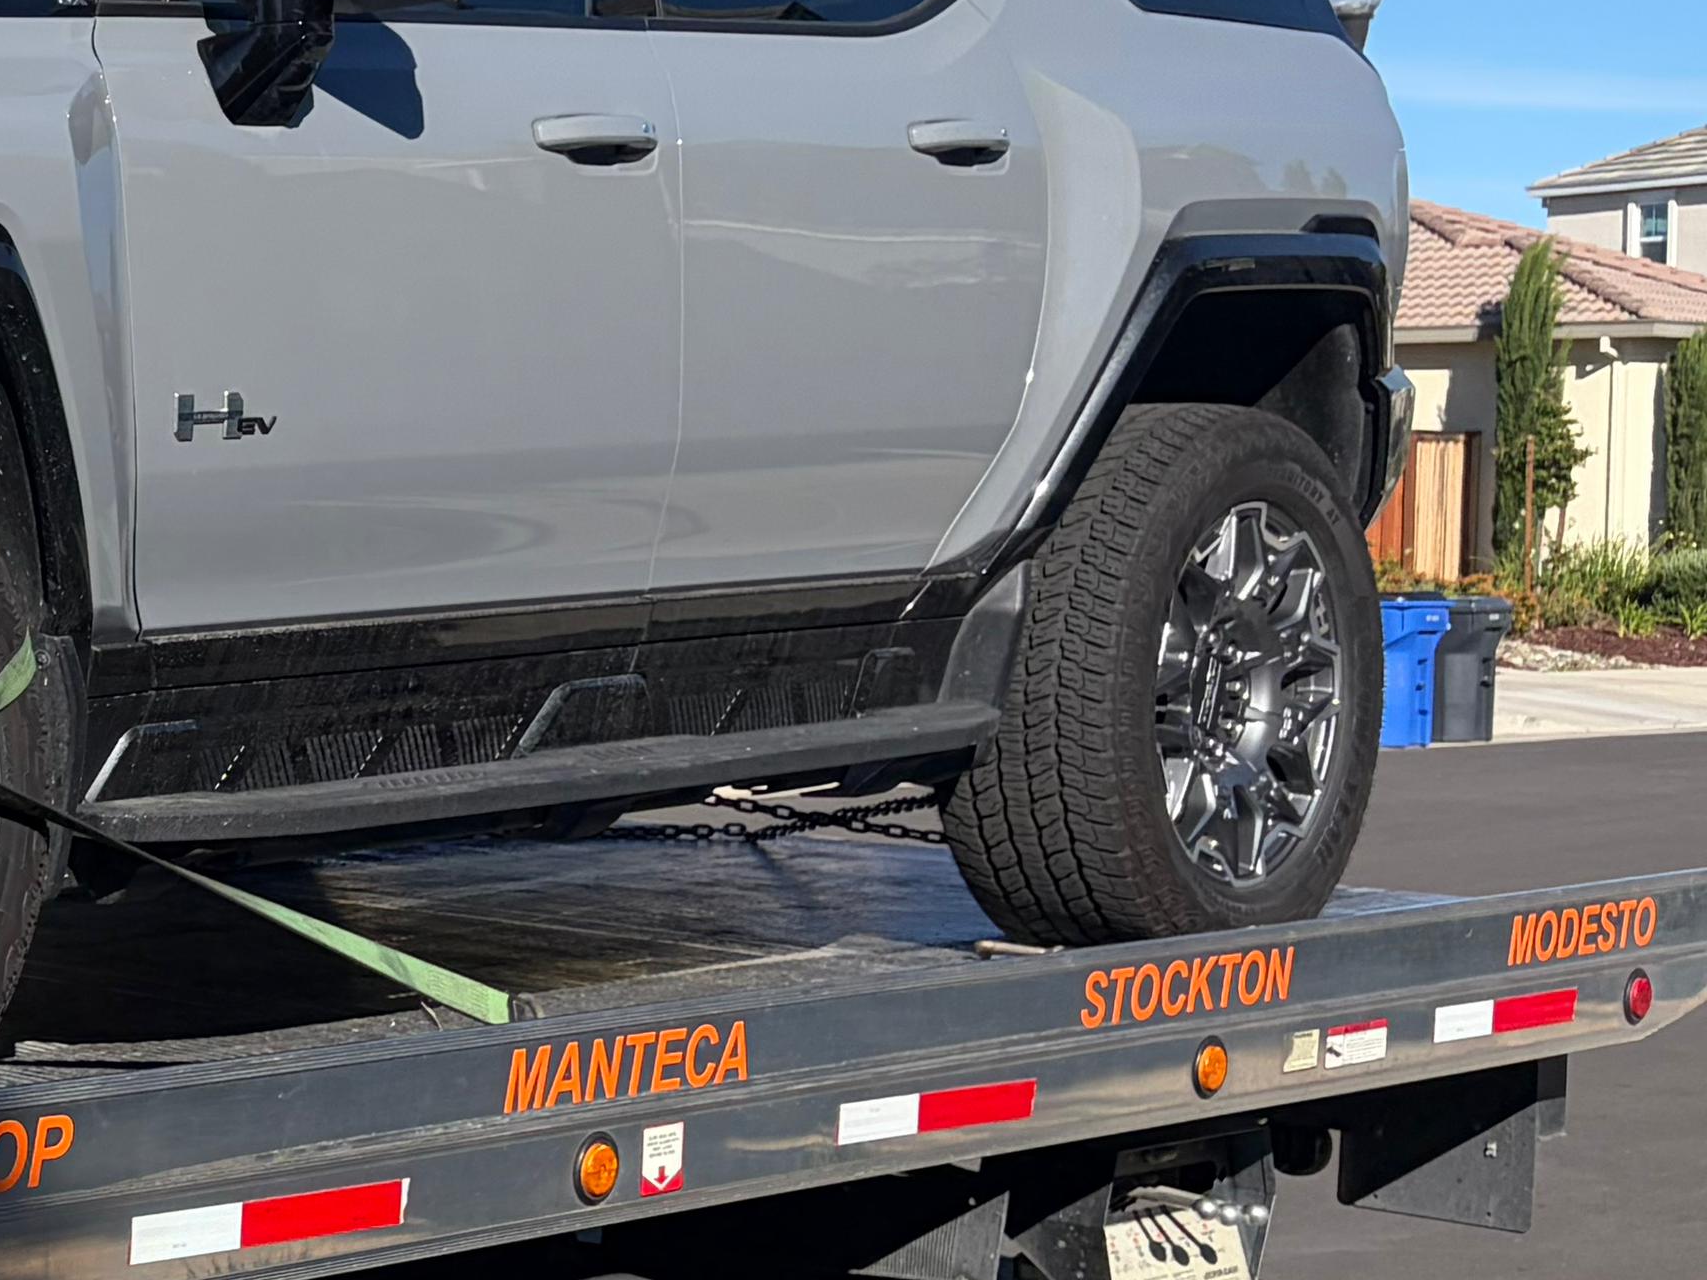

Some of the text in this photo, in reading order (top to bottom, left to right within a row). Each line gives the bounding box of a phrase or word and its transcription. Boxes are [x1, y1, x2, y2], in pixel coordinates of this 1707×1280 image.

[1508, 897, 1658, 966] MODESTO
[1080, 946, 1296, 1030] STOCKTON
[503, 1020, 749, 1114] MANTECA
